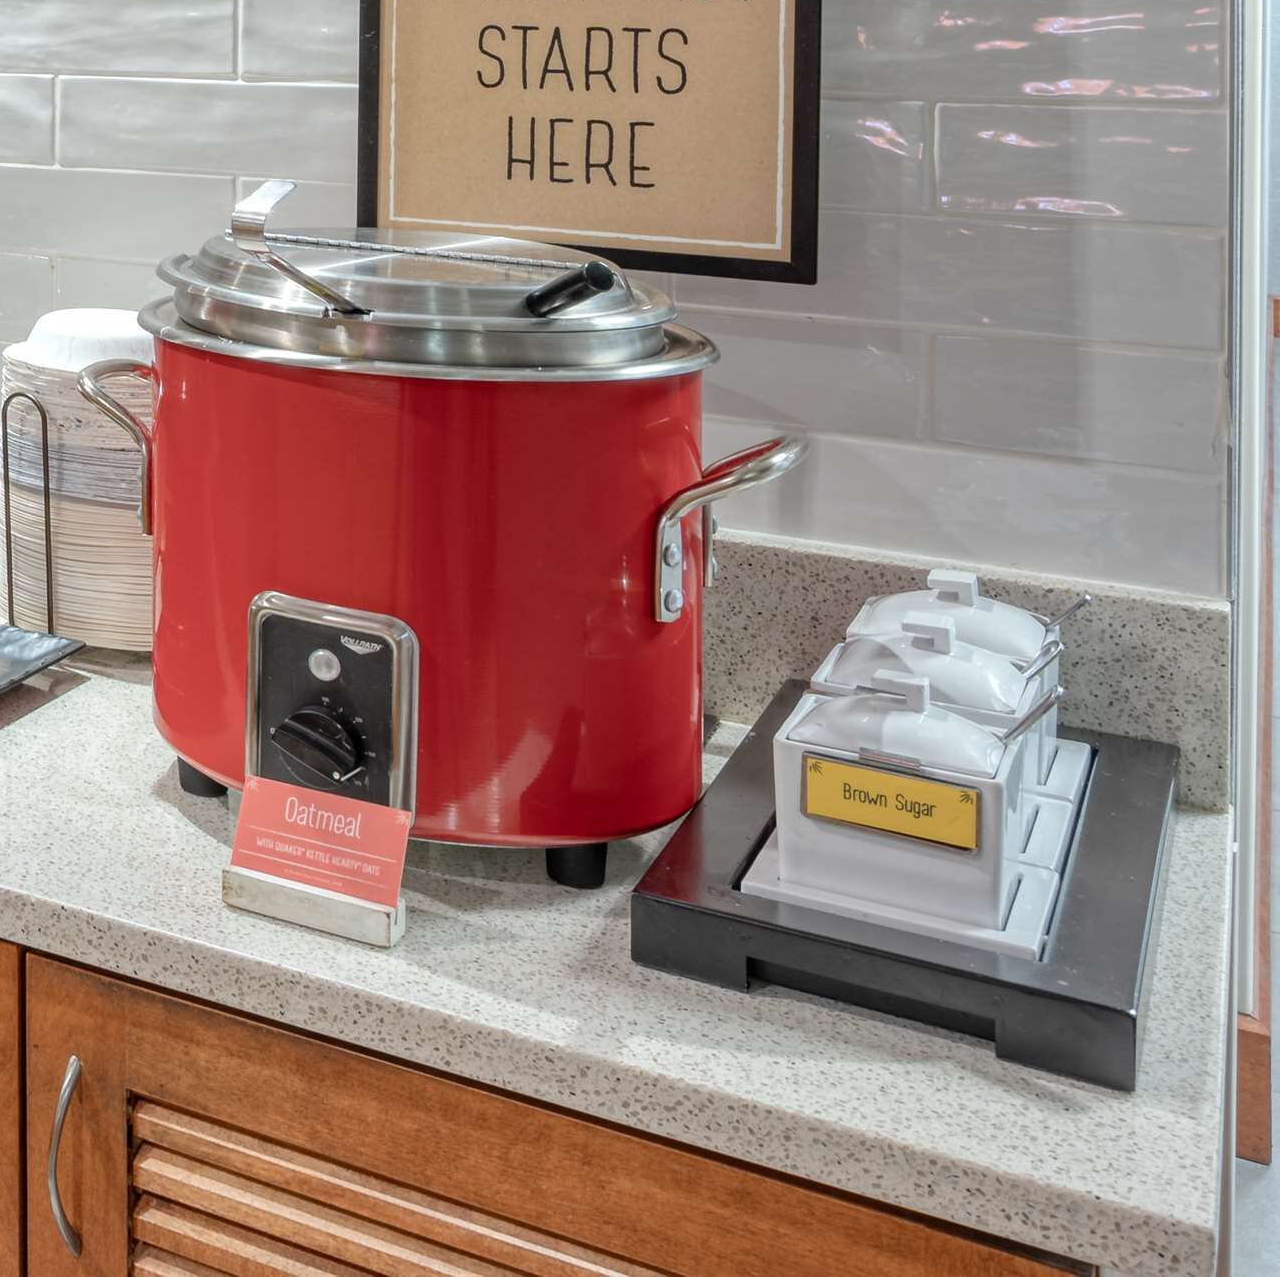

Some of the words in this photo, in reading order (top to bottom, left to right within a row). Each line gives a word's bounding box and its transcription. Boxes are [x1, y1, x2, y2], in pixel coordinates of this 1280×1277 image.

[476, 23, 689, 95] STARTS
[507, 115, 656, 188] HERE
[285, 797, 361, 839] Oatmeal
[842, 782, 888, 808] Brown
[895, 793, 937, 818] Sugar
